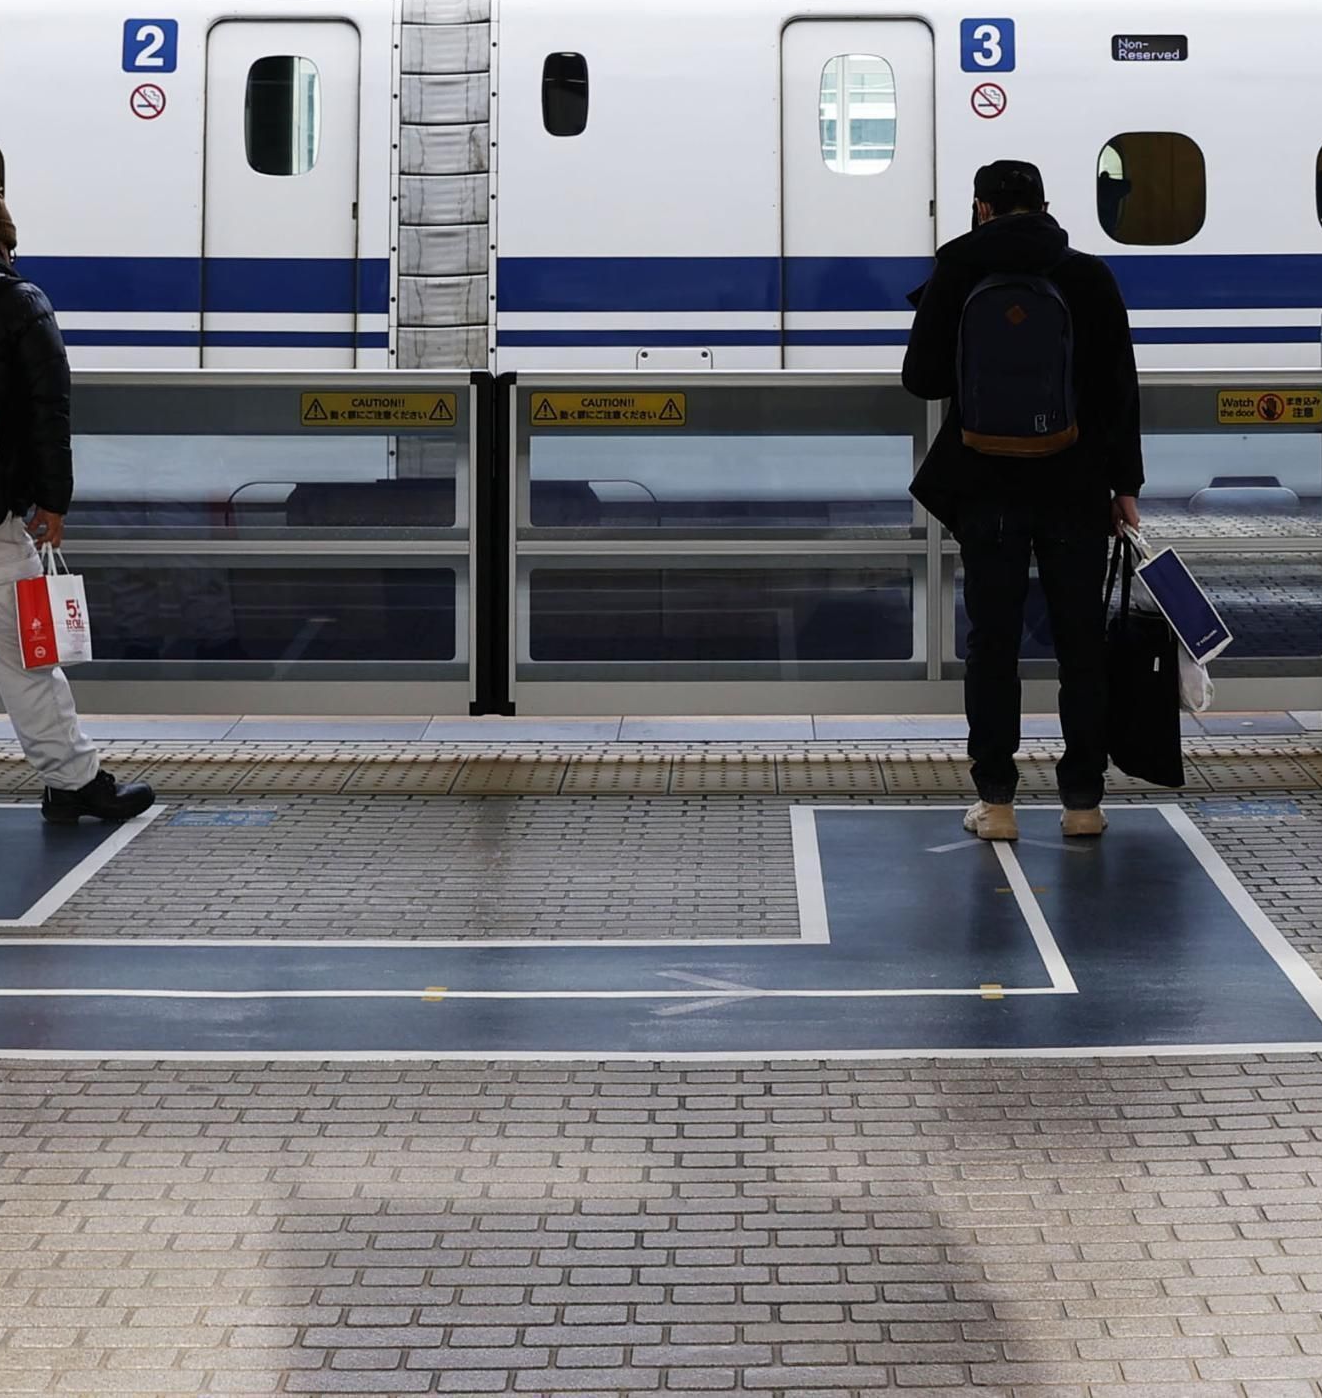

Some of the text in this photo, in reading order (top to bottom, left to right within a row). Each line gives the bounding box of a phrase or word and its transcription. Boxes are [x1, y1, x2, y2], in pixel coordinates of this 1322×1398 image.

[135, 25, 165, 67] 2
[972, 24, 1003, 67] 3
[1118, 38, 1149, 49] Non-
[1118, 49, 1180, 60] Reserved
[351, 398, 405, 408] CAUTION!!
[581, 398, 635, 408] CAUTION!!
[1222, 397, 1254, 407] Watch
[1235, 409, 1255, 418] door
